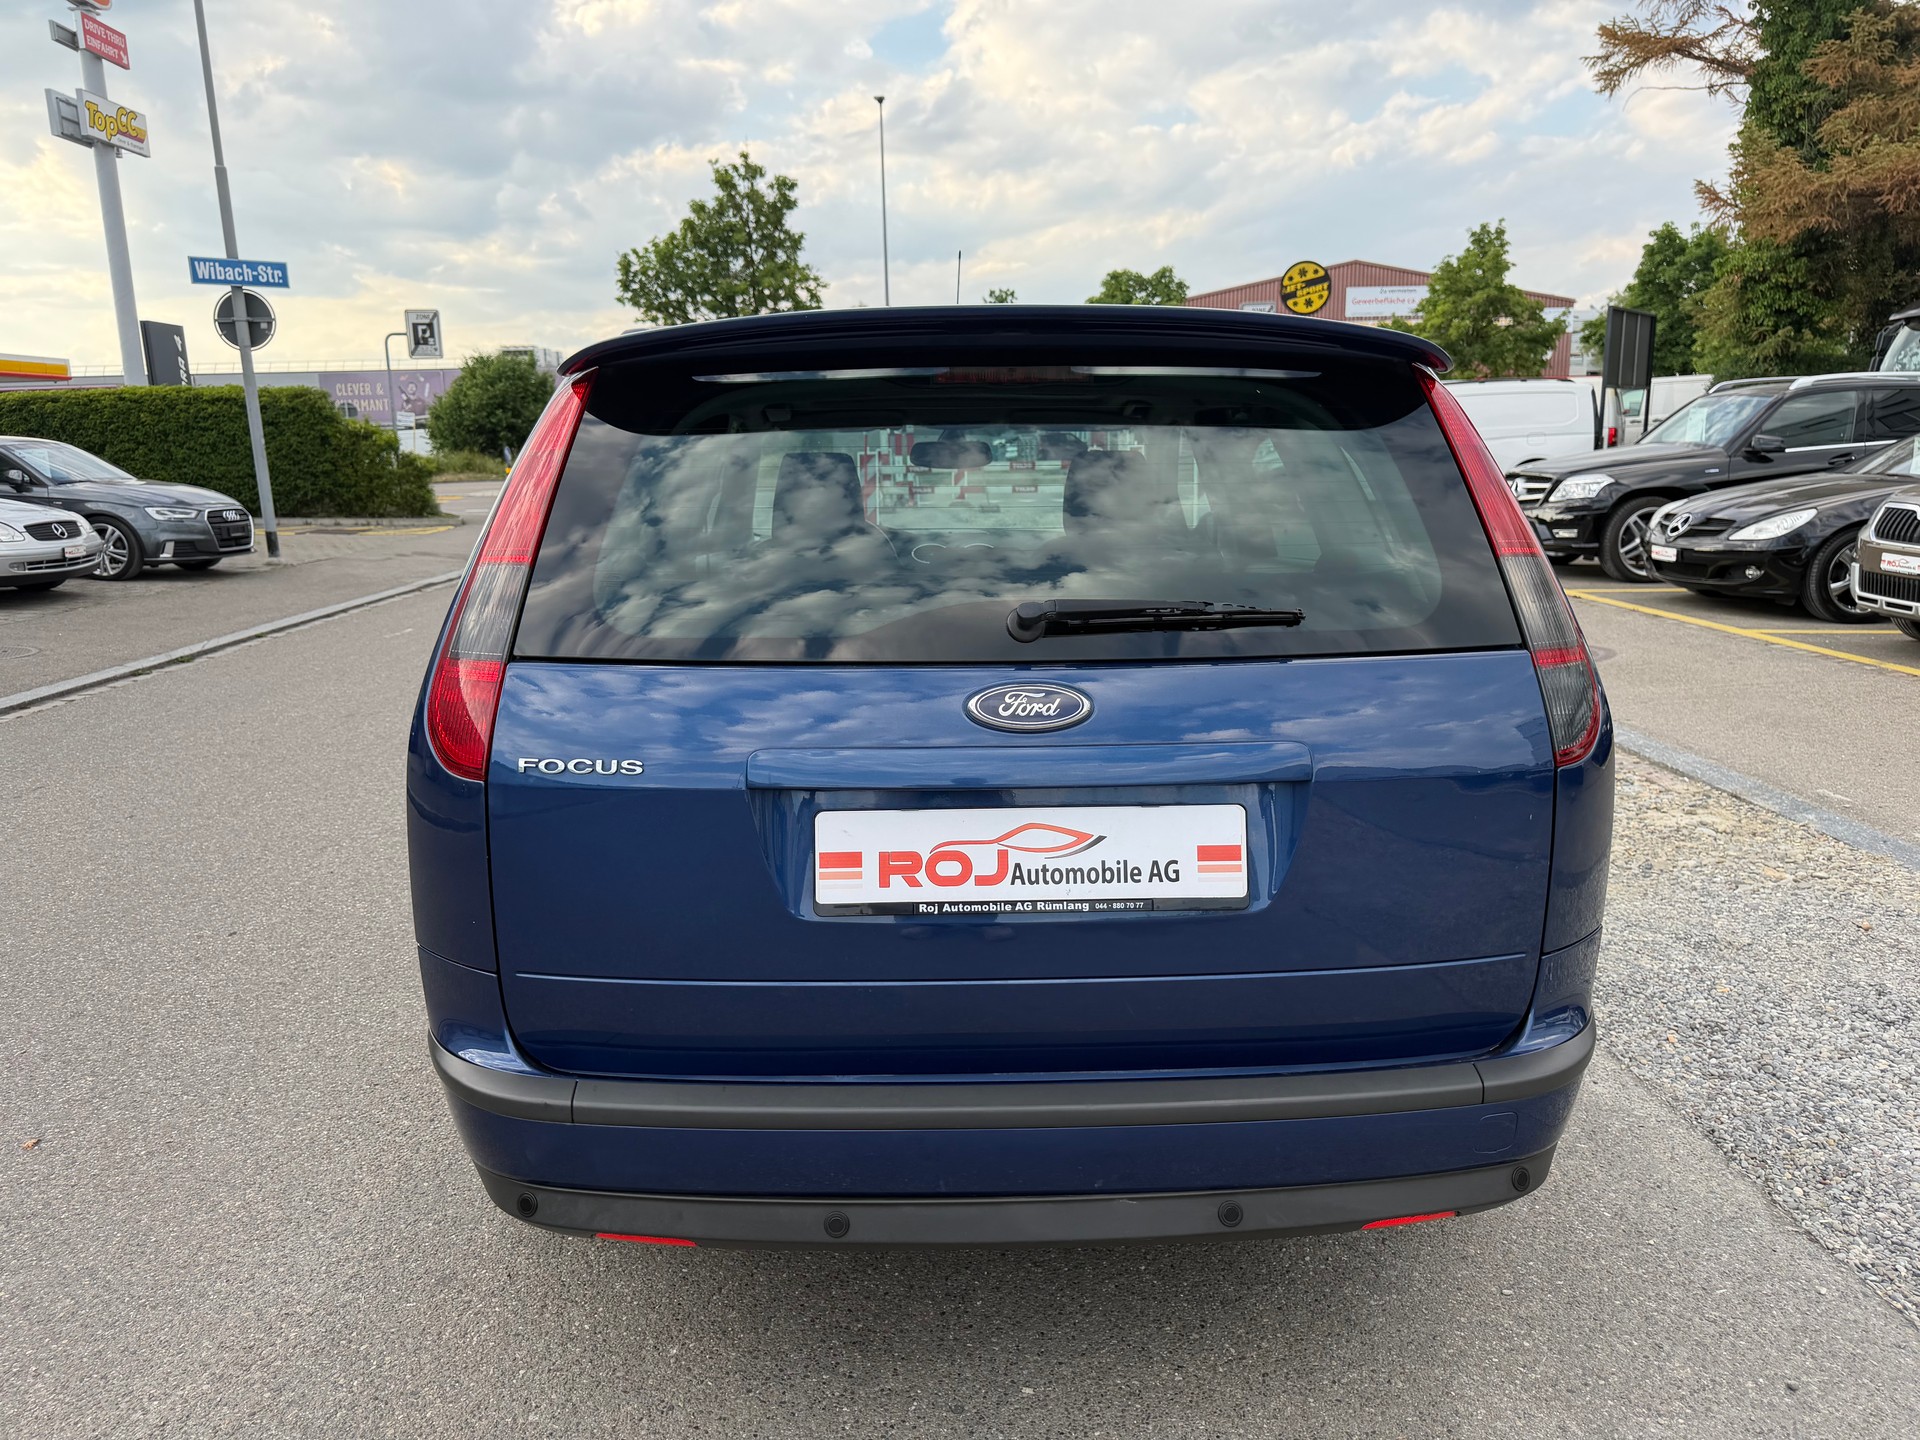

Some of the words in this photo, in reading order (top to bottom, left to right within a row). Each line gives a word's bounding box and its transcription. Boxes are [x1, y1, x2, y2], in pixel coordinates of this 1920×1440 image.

[84, 18, 106, 39] DRIVE
[106, 29, 125, 48] THRU
[86, 34, 119, 59] EINFAHRT
[85, 100, 138, 141] TopCC
[194, 260, 284, 284] Wibach-Str.
[335, 382, 372, 396] CLEVER
[376, 382, 384, 396] &
[998, 691, 1061, 717] Ford
[518, 757, 644, 776] FOCUS
[878, 849, 1009, 888] ROJ
[1010, 859, 1142, 886] Automobile
[1147, 859, 1181, 884] AG
[919, 903, 939, 914] Roj
[942, 901, 1012, 913] Automobile
[1014, 901, 1033, 912] AG
[1036, 900, 1090, 912] Rümlang
[1094, 902, 1108, 910] 044
[1112, 901, 1125, 910] 880
[1126, 901, 1135, 910] 70
[1135, 901, 1144, 909] 77
